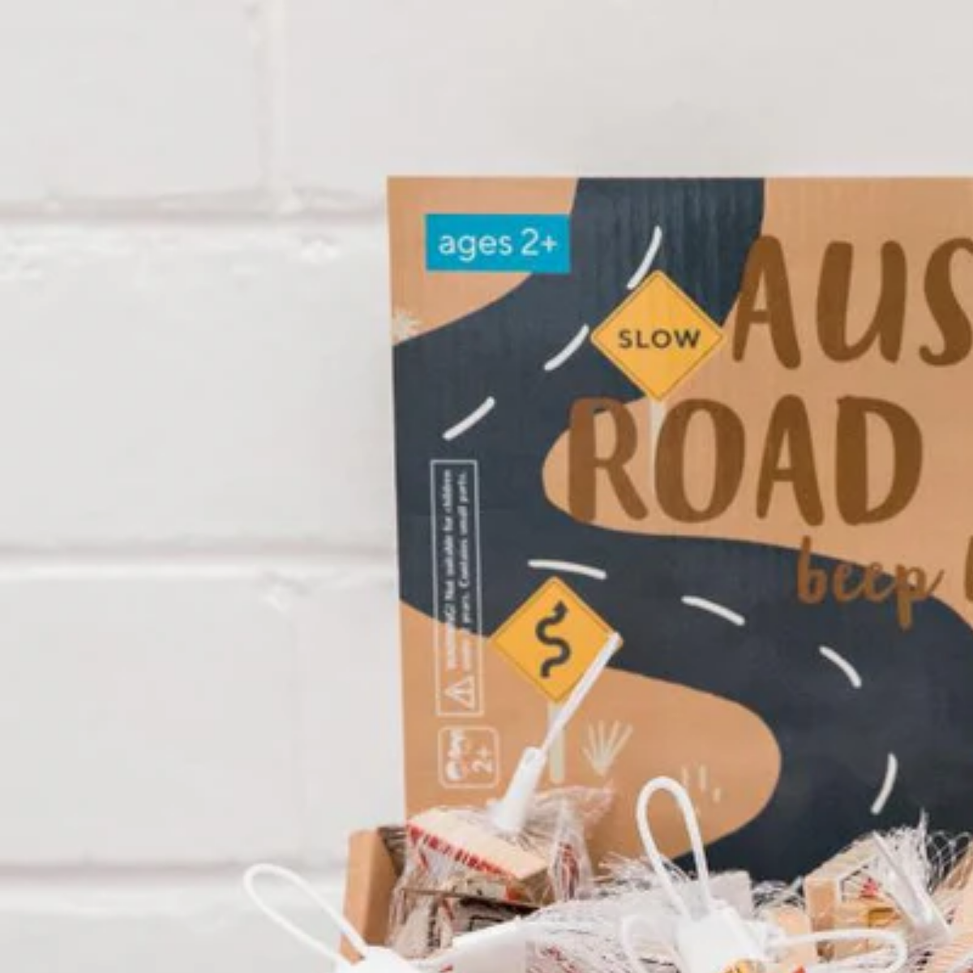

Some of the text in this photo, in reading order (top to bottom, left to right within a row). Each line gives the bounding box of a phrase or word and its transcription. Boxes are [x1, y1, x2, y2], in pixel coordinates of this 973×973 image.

[438, 228, 558, 262] ages 2+
[618, 329, 701, 349] SLOW
[567, 393, 924, 527] ROAD
[796, 535, 943, 630] beep
